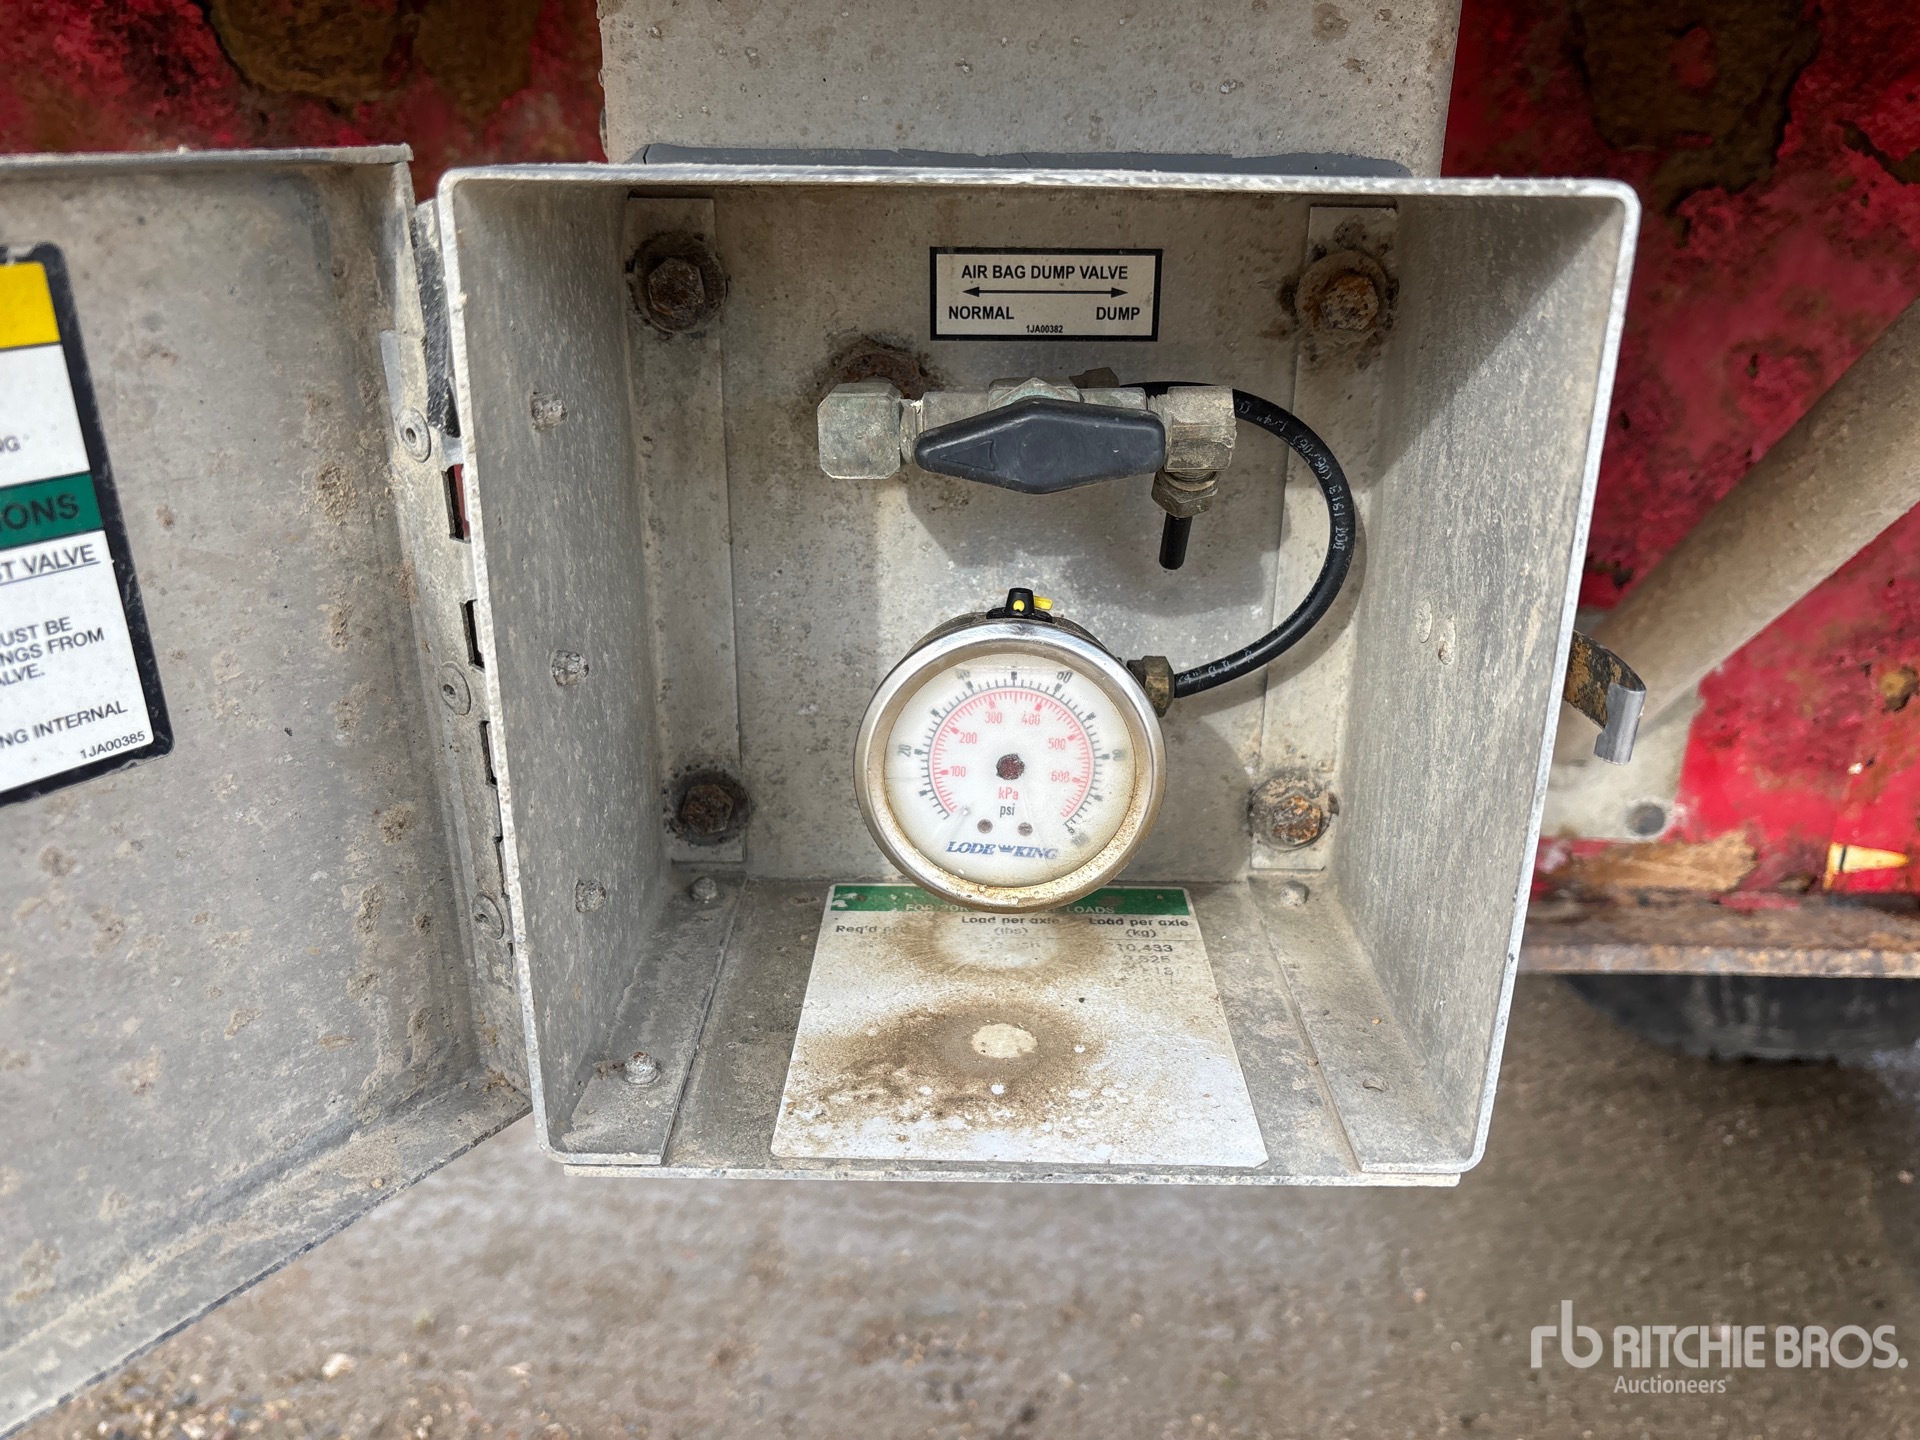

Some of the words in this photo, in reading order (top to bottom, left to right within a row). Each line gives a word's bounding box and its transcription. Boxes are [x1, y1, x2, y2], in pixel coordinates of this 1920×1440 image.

[961, 264, 988, 279] AIR
[992, 265, 1026, 279] BAG
[1030, 265, 1076, 280] DUMP
[1080, 265, 1128, 280] VALVE
[948, 305, 1015, 320] NORMAL
[1095, 306, 1141, 321] DUMP
[1025, 324, 1064, 334] 1JA00382
[22, 543, 97, 576] VALVE
[46, 616, 73, 636] BE
[47, 627, 105, 655] FROM
[0, 662, 45, 687] LVE.
[33, 700, 129, 739] INTERNAL
[984, 711, 1003, 725] 300
[79, 730, 146, 760] 1JA00385
[959, 732, 978, 745] 200
[950, 765, 967, 778] 100
[998, 786, 1020, 801] kPa
[999, 803, 1015, 818] psi
[945, 840, 996, 856] LODE
[1012, 845, 1059, 860] KING
[1066, 906, 1115, 914] LOADS
[961, 916, 997, 925] Load
[1001, 917, 1026, 926] per
[1089, 917, 1124, 926] Load
[1129, 918, 1152, 927] per
[1158, 918, 1189, 927] axle
[835, 924, 877, 935] Req'd
[1125, 928, 1157, 938] (kg)
